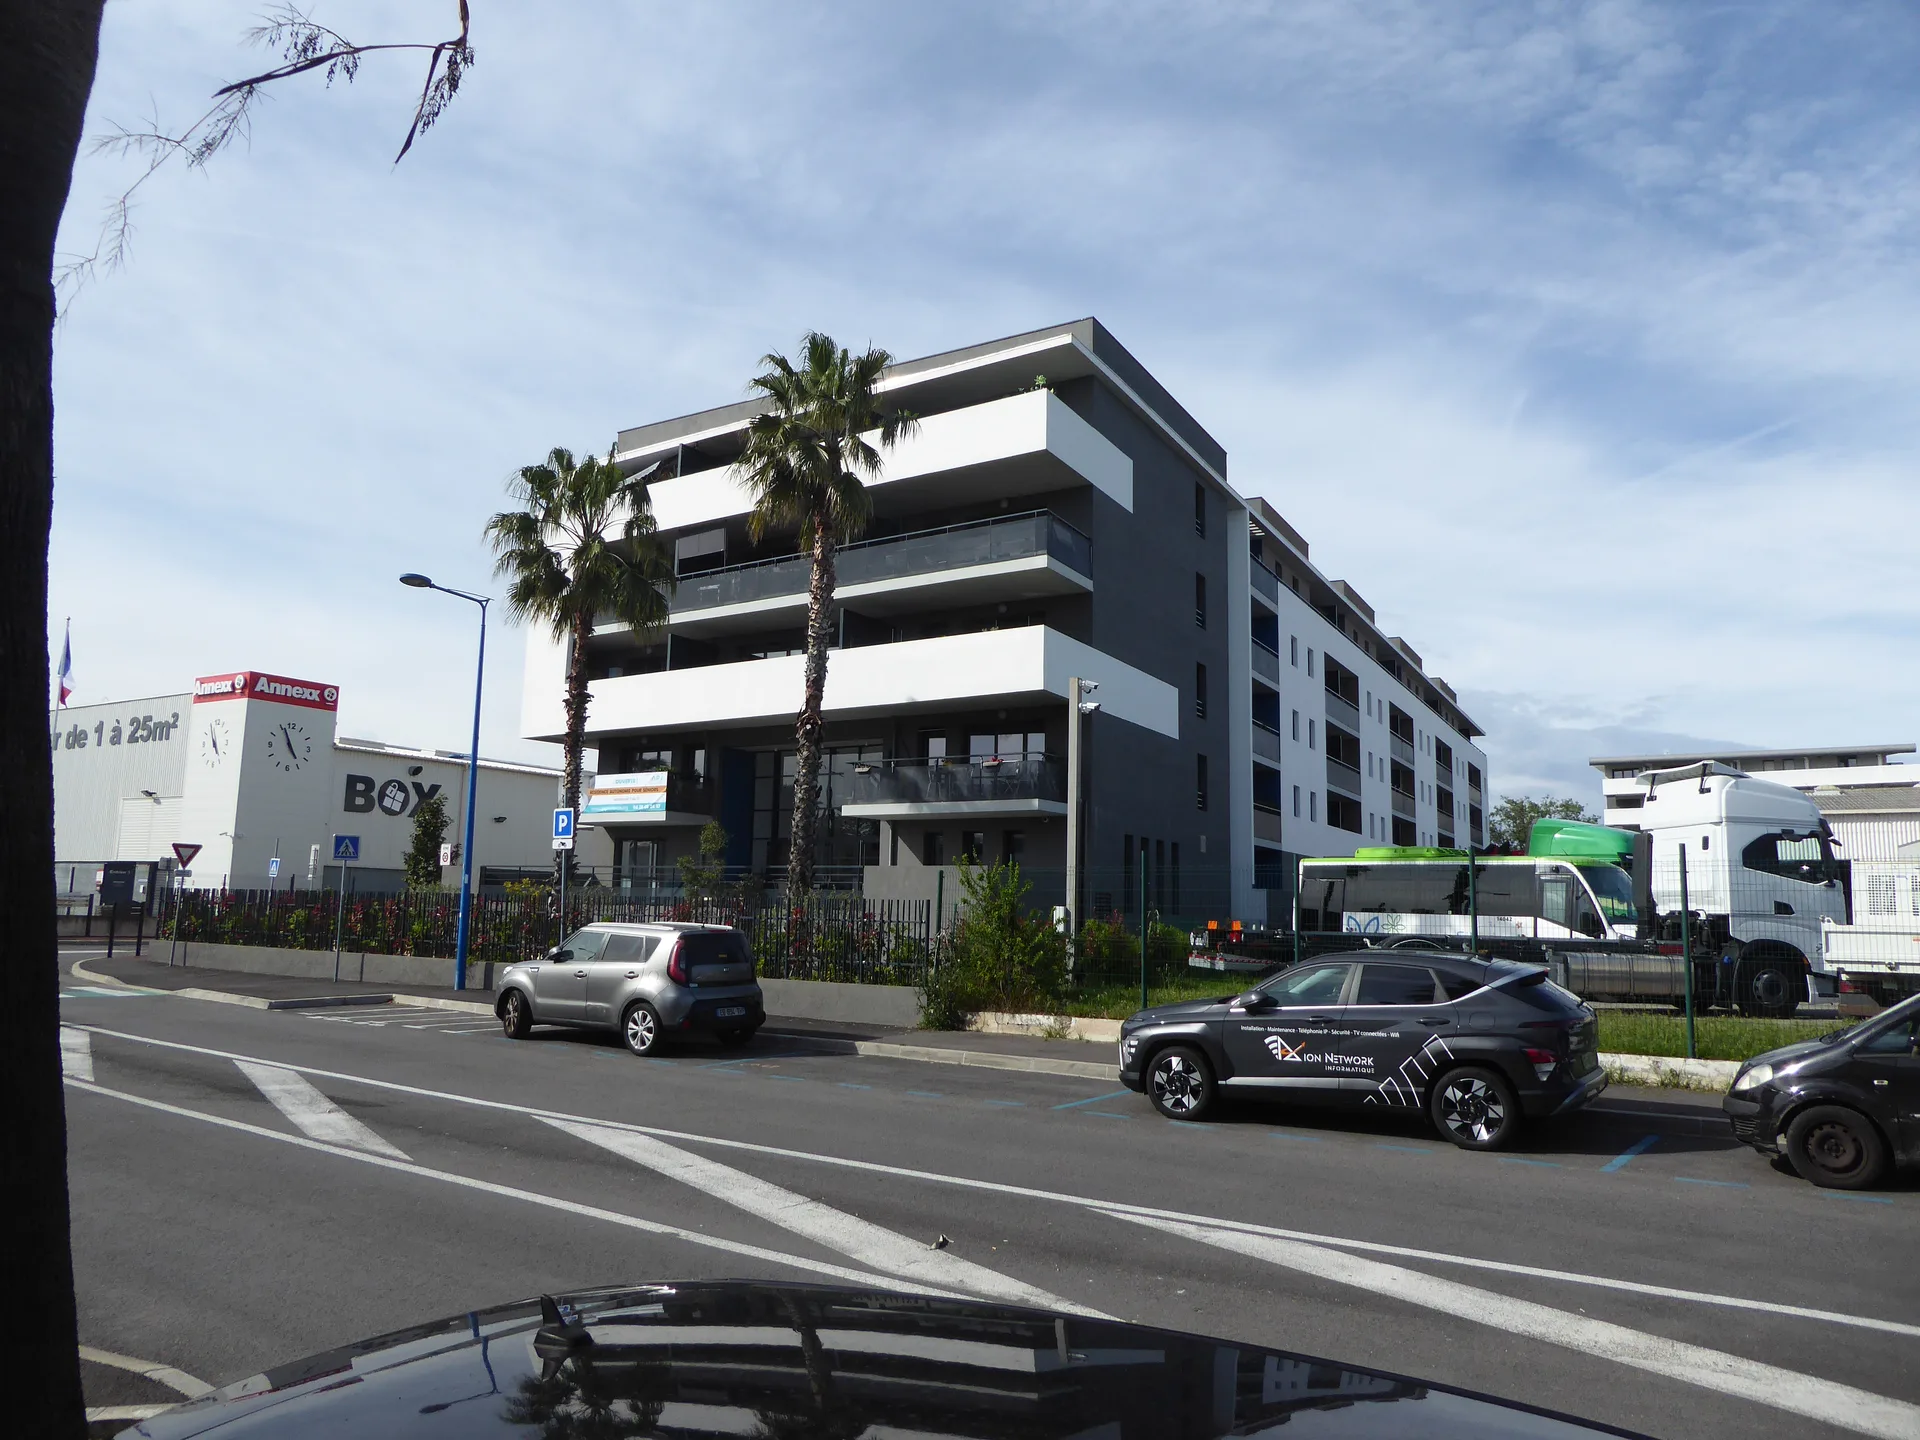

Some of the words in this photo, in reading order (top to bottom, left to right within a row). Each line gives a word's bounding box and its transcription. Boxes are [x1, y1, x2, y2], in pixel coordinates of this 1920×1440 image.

[194, 680, 233, 696] Annexx
[254, 677, 320, 701] Annexx
[287, 722, 296, 730] 12
[65, 723, 88, 750] de
[94, 720, 104, 747] 1
[109, 718, 122, 746] à
[268, 741, 273, 749] 9
[306, 745, 311, 753] 3
[285, 764, 290, 772] 6
[343, 773, 442, 818] BOX
[558, 814, 568, 832] P
[1298, 1027, 1323, 1035] Téléphonie
[1360, 1030, 1387, 1038] connectées
[1325, 1065, 1375, 1074] INFORMATIQUE
